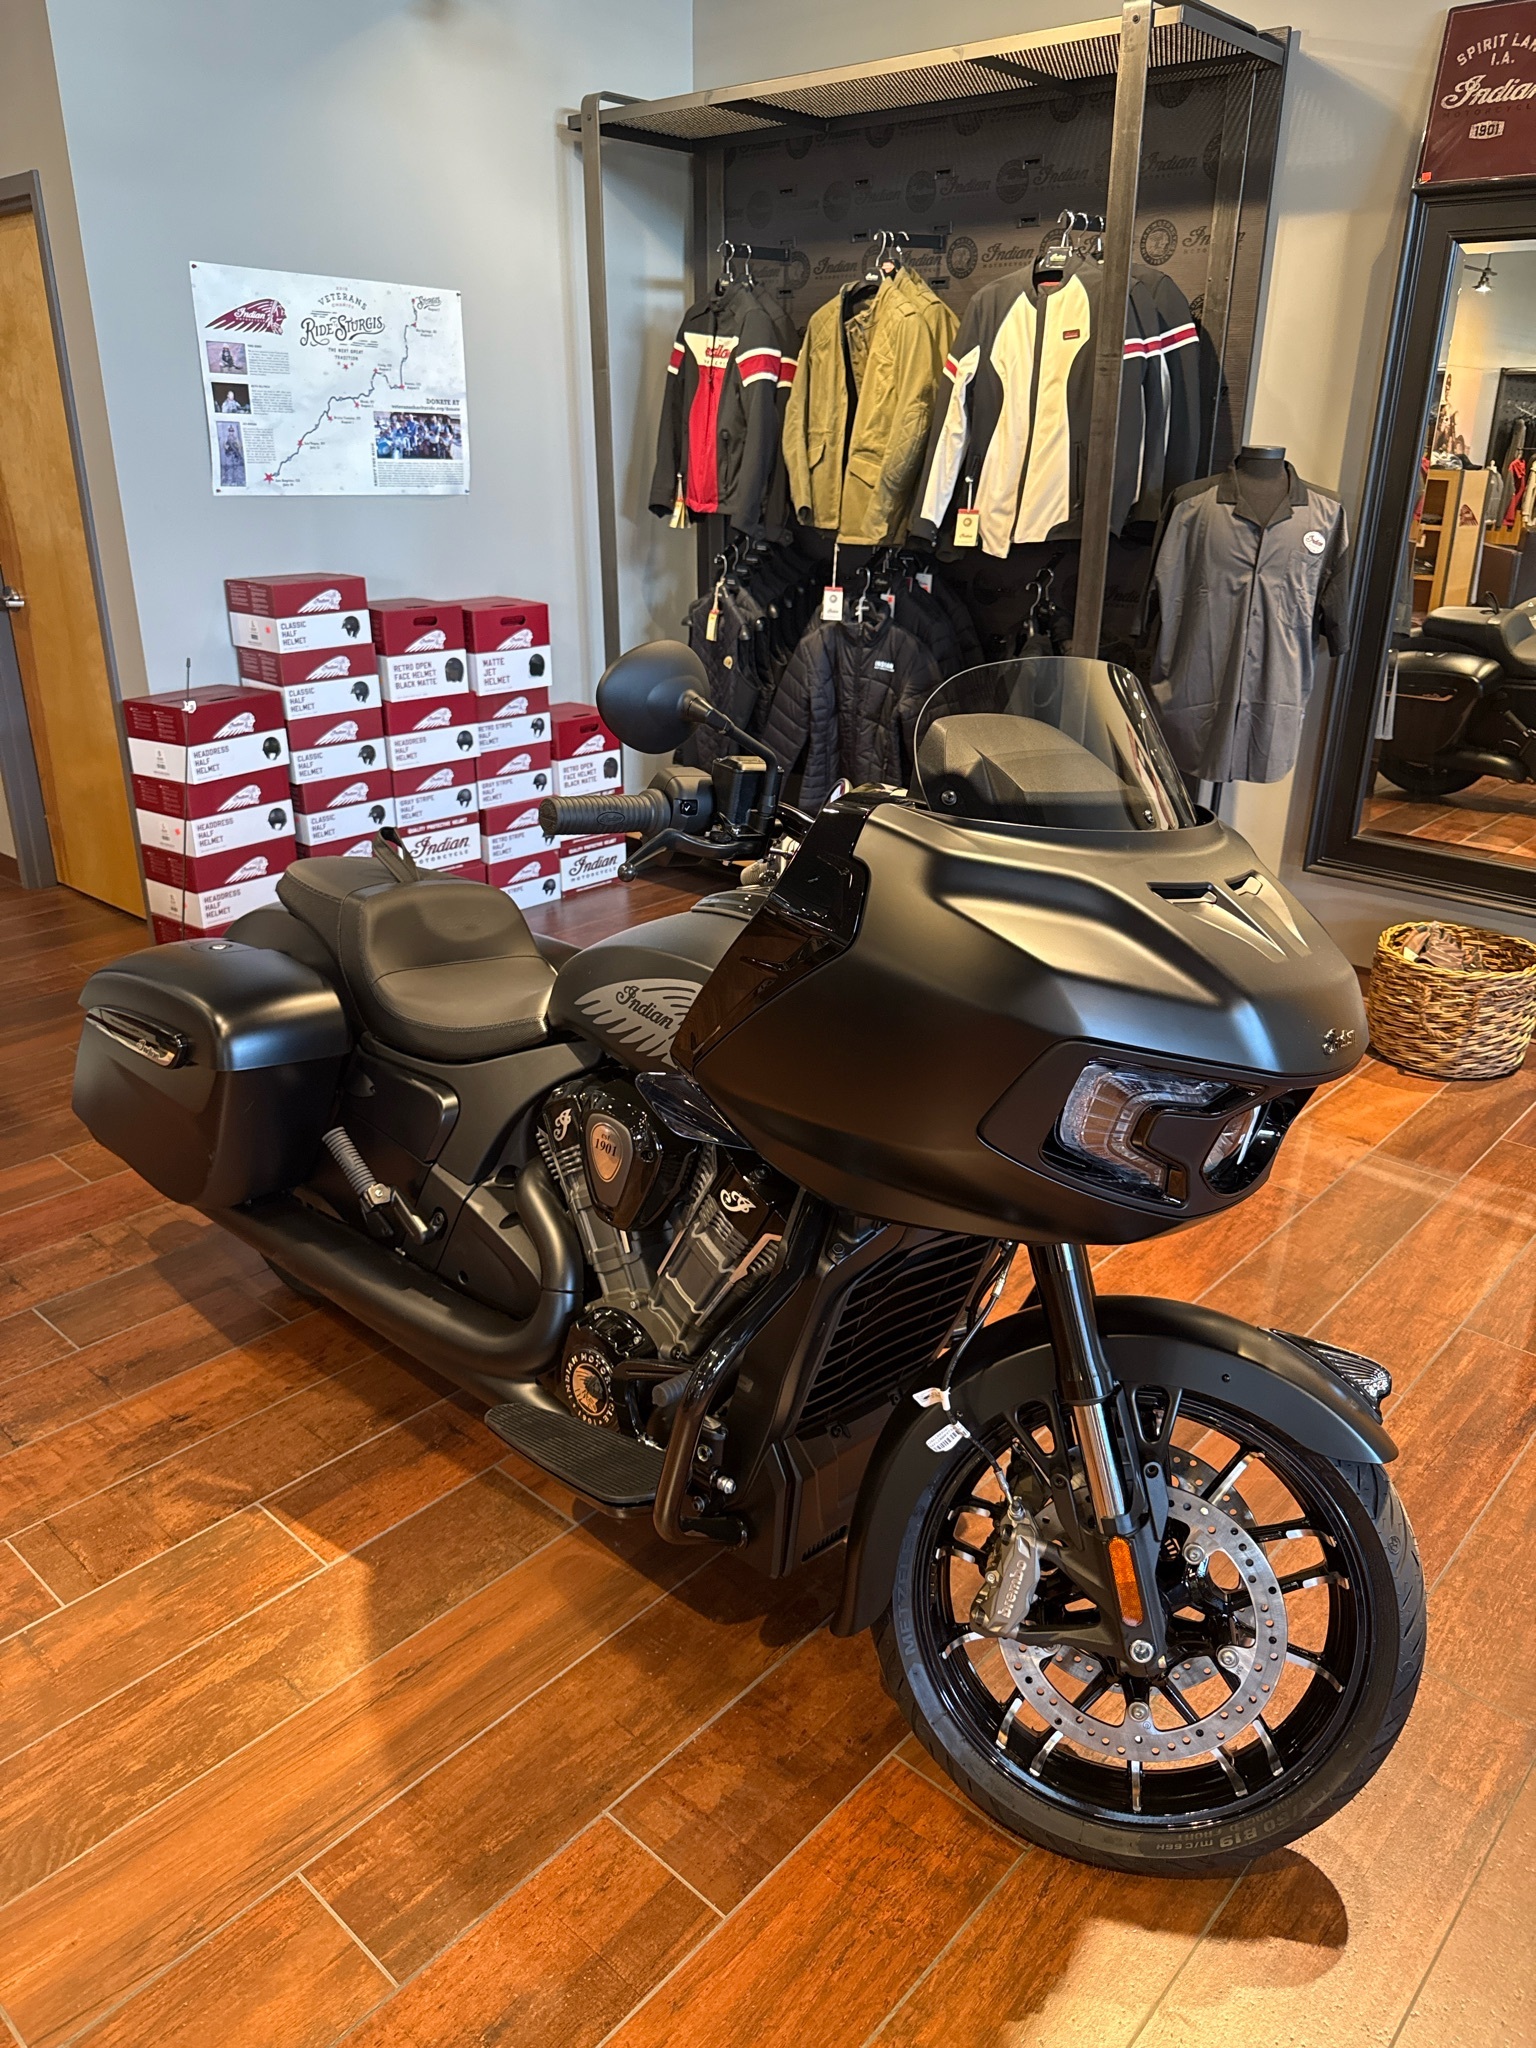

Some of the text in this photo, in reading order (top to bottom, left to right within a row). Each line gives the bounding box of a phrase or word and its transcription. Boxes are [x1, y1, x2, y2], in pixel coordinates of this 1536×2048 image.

[1456, 33, 1509, 66] SPIRIT
[1474, 123, 1501, 137] 1901
[1032, 163, 1089, 185] Indian
[981, 242, 1035, 263] Indian
[813, 256, 858, 275] Indian
[317, 292, 369, 311] VETERANS
[233, 308, 267, 320] Indian
[300, 317, 335, 347] RIDE
[334, 314, 386, 341] STURGIS
[280, 621, 307, 631] CLASSIC
[281, 630, 298, 638] HALF
[282, 637, 307, 646] HELMET
[393, 661, 432, 672] RETRO OPEN
[482, 657, 505, 667] MATTE
[394, 669, 437, 681] FACE HELMET
[483, 668, 497, 677] JET
[395, 678, 438, 690] BLACK MATTE
[484, 676, 511, 686] HELMET
[289, 687, 315, 698] CLASSIC
[290, 703, 315, 712] HELMET
[479, 738, 499, 746] HELMET
[193, 745, 230, 759] HEADDRESS
[395, 746, 409, 755] HALF
[194, 758, 210, 767] HALF
[297, 752, 324, 763] CLASSIC
[395, 752, 418, 762] HELMET
[196, 763, 220, 775] HELMET
[299, 768, 323, 777] HELMET
[563, 762, 594, 773] RETRO OPEN
[563, 769, 597, 782] FACE HELMET
[564, 776, 597, 789] BLACK MATTE
[483, 793, 503, 802] HELMET
[400, 805, 415, 813] HALF
[310, 814, 336, 825] CLASSIC
[401, 810, 423, 820] HELMET
[197, 818, 234, 832] HEADDRESS
[311, 824, 326, 832] HALF
[198, 830, 215, 839] HALF
[312, 829, 336, 839] HELMET
[199, 836, 224, 848] HELMET
[409, 836, 470, 859] Indian
[415, 849, 469, 865] OTORCYCLE
[493, 847, 512, 857] HELMET
[568, 855, 618, 877] Indian
[204, 889, 241, 903] HEADDRESS
[205, 901, 221, 911] HALF
[206, 907, 231, 919] HELMET
[615, 985, 674, 1030] Indian
[601, 1131, 612, 1141] est
[594, 1138, 618, 1158] 1901
[565, 1355, 578, 1399] INDIAN
[997, 1559, 1028, 1619] brembo
